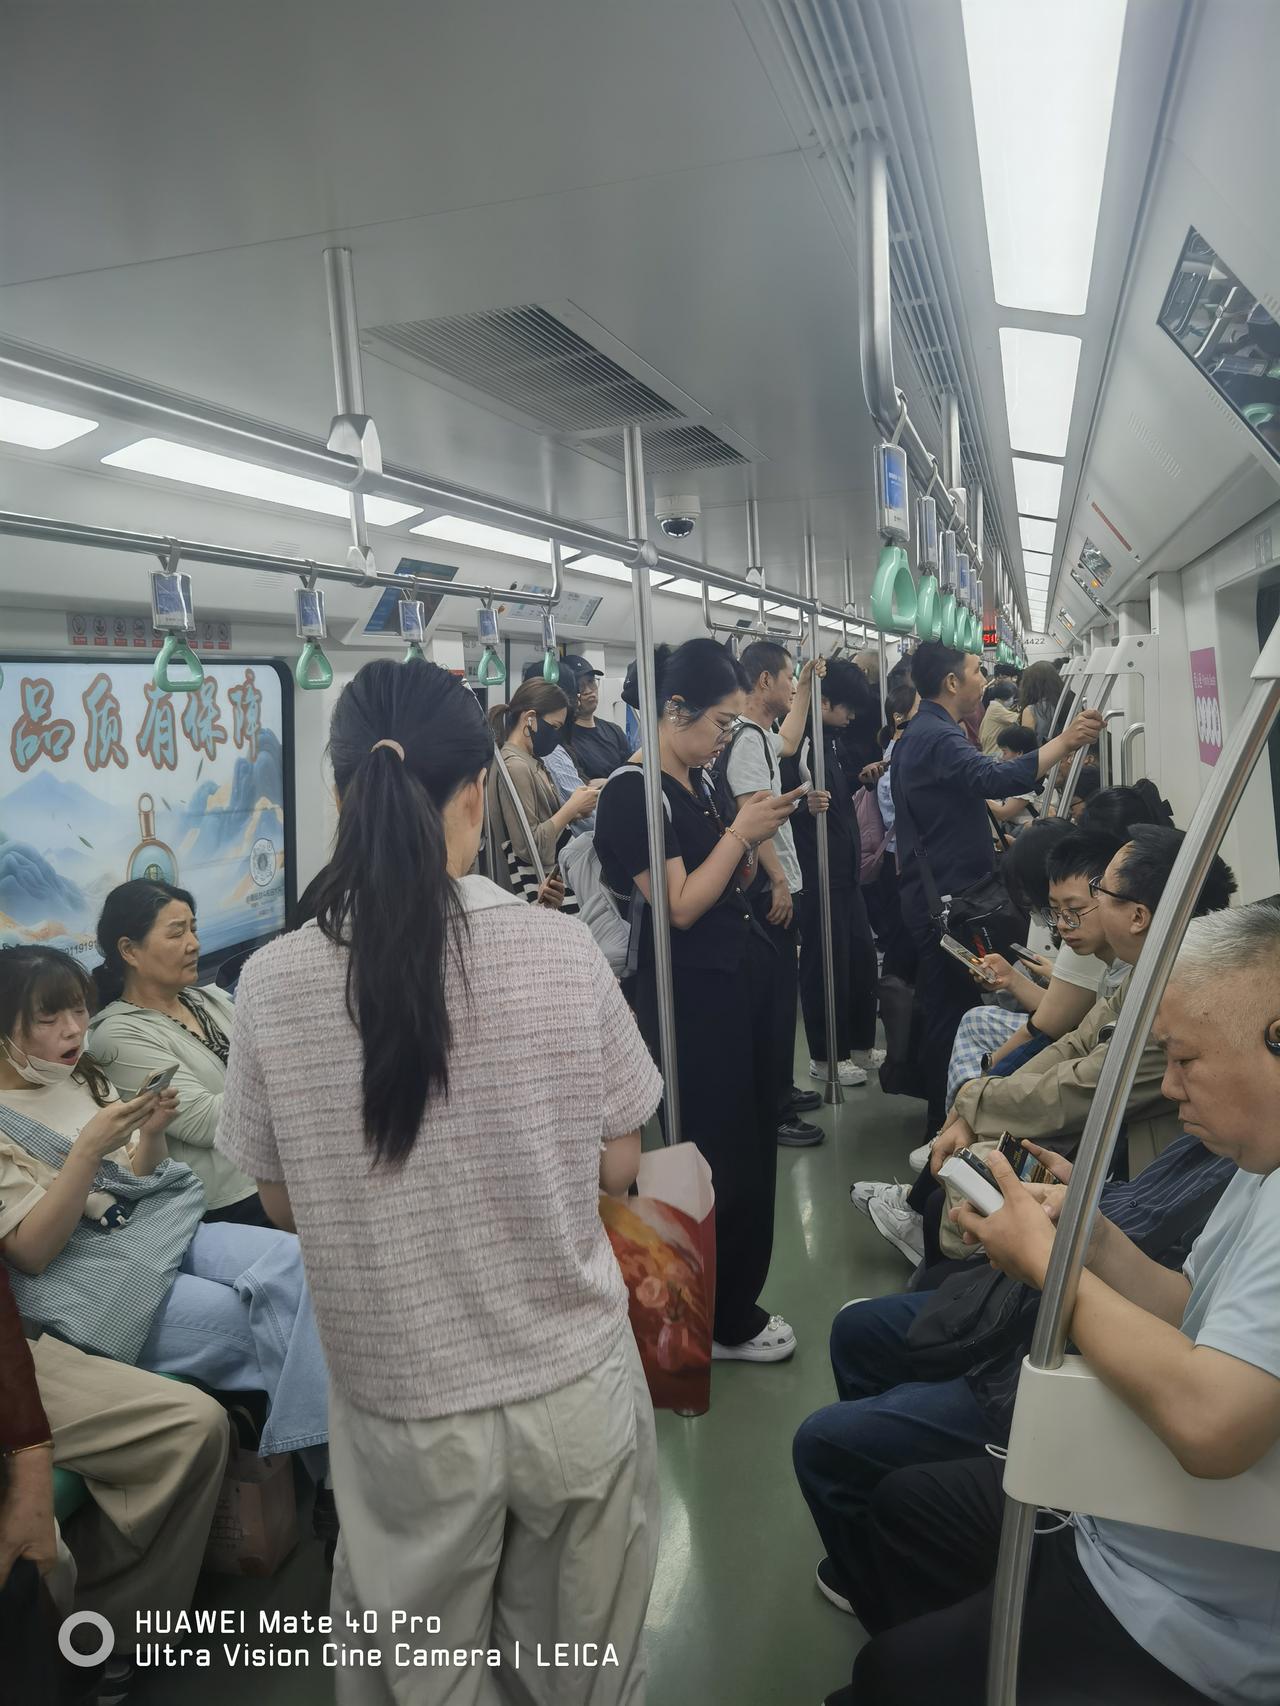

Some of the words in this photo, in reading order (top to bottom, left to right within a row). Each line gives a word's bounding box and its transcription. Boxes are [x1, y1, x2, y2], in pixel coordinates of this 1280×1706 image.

[10, 668, 263, 773] 品质有保障
